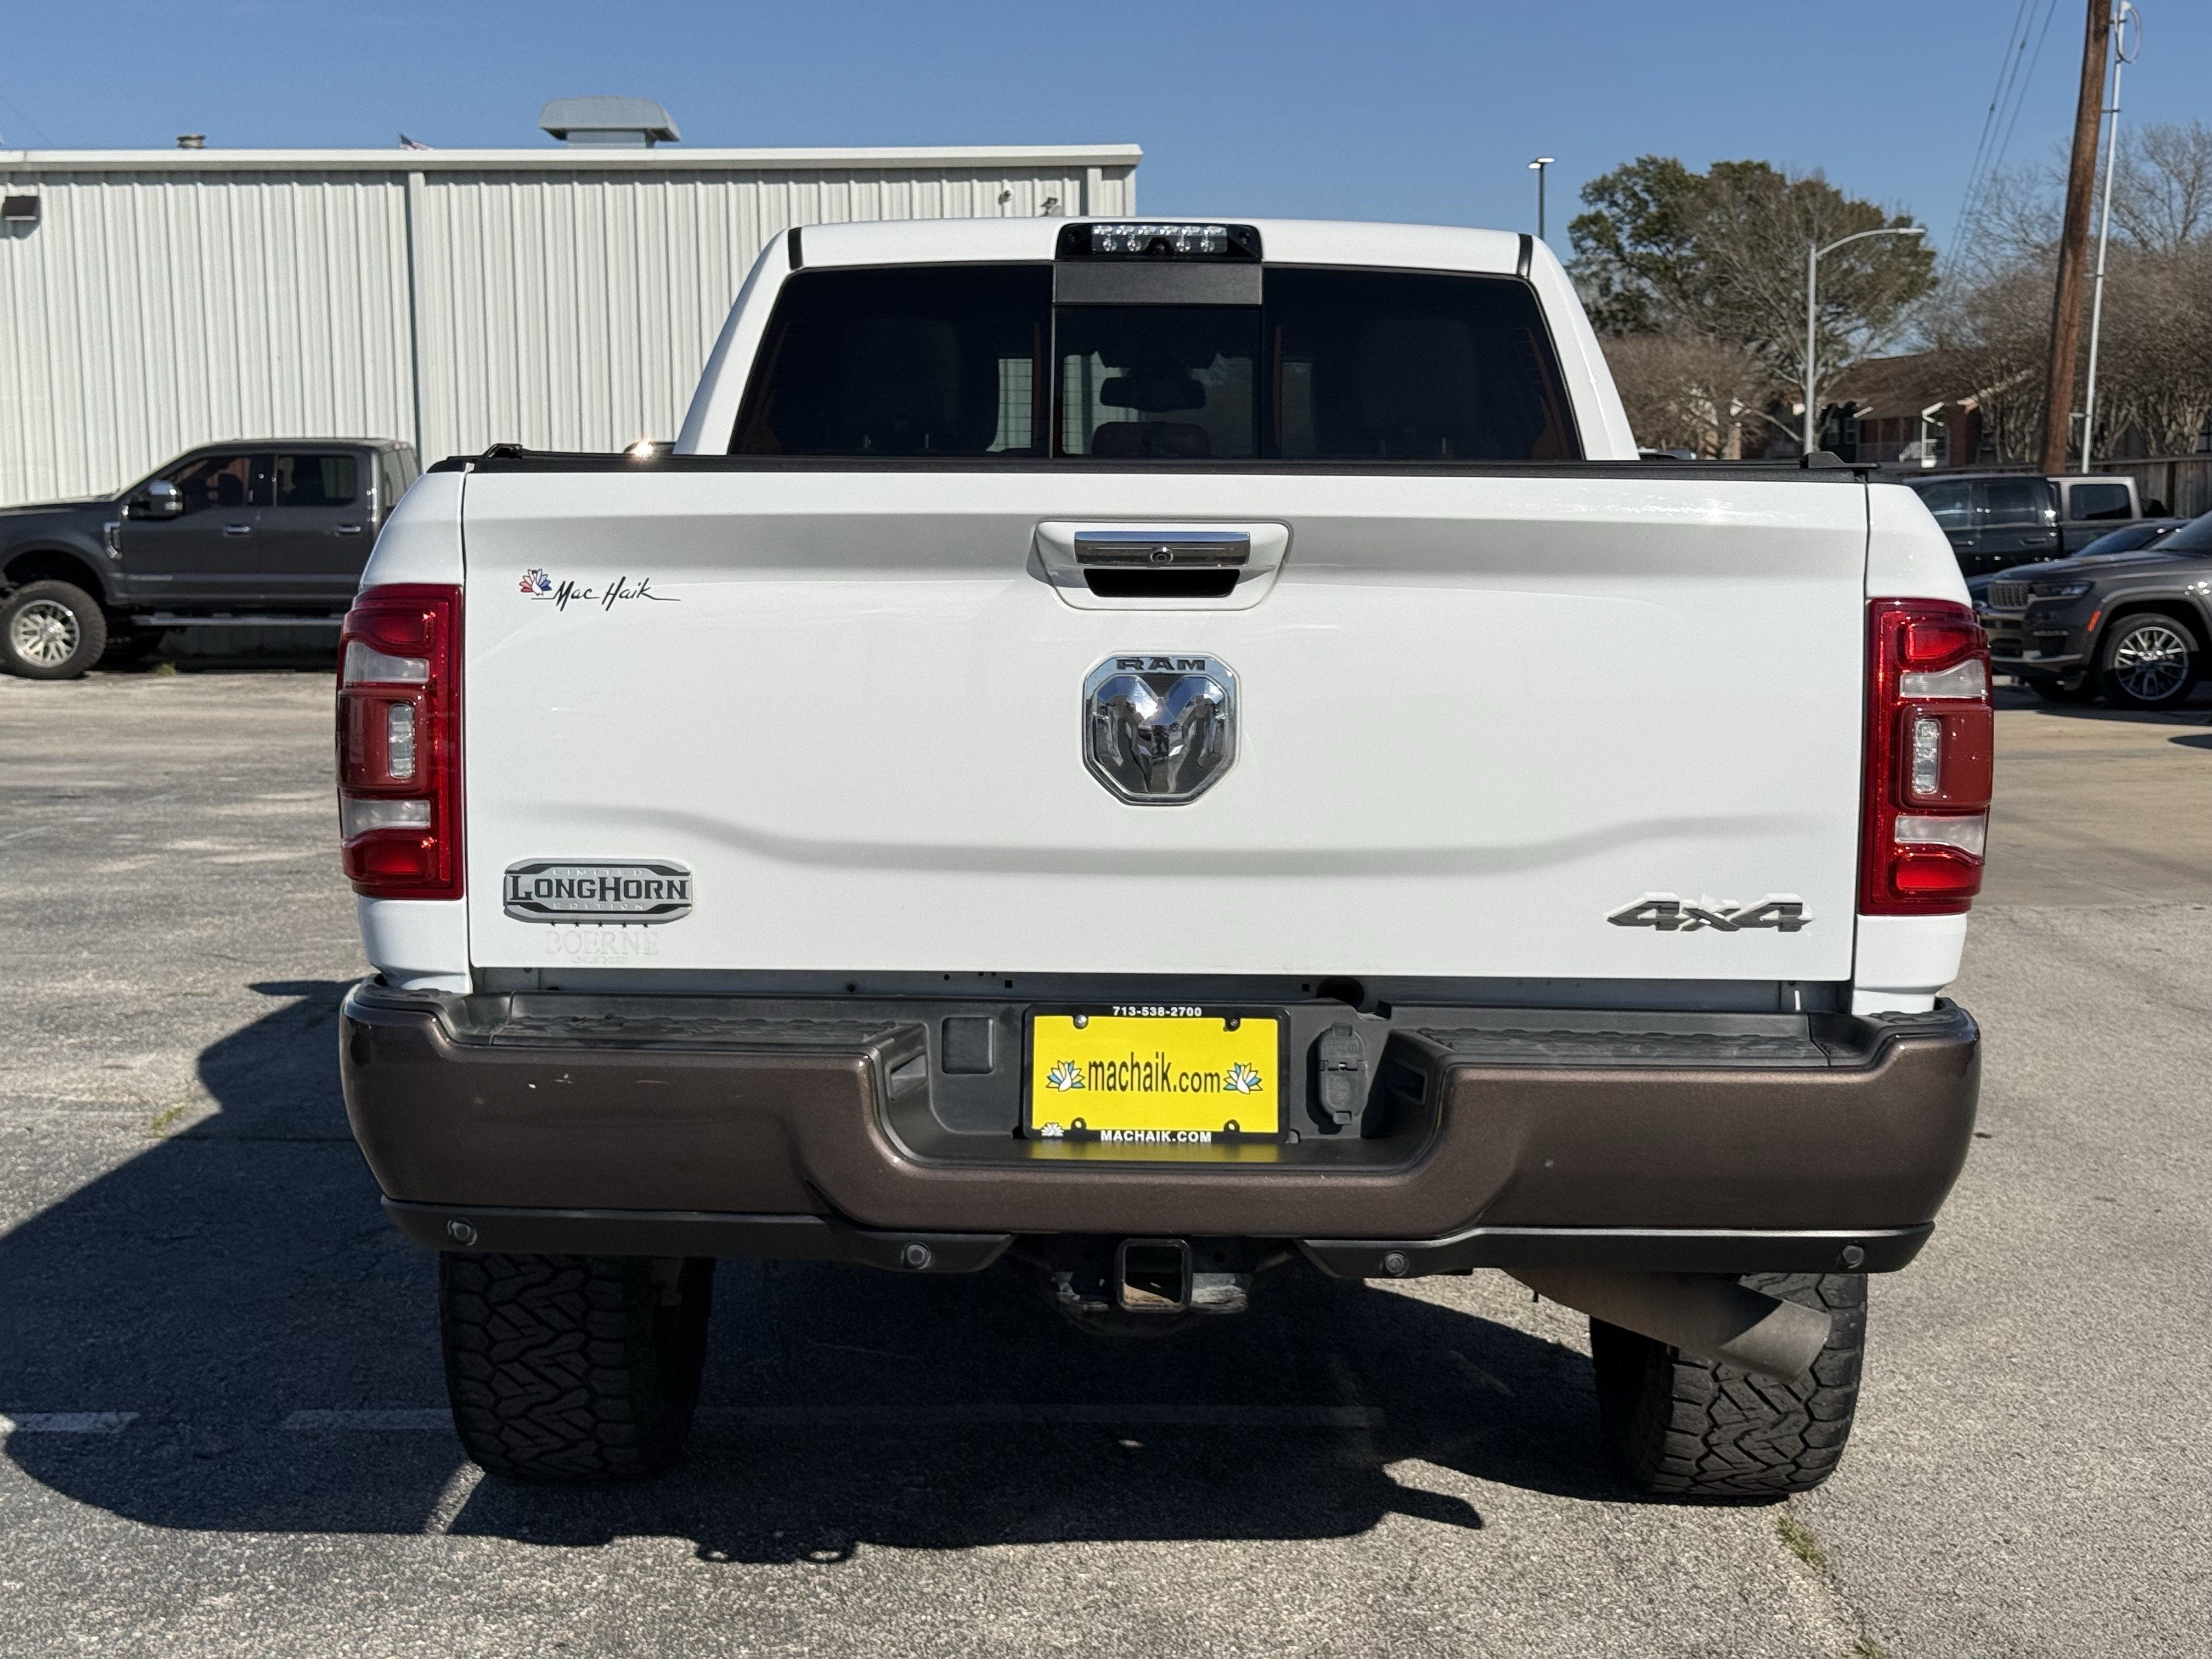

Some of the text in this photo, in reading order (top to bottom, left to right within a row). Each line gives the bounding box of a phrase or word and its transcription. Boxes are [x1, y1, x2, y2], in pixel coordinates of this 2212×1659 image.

[531, 575, 681, 612] Mac Haik
[1117, 658, 1205, 670] RAM
[544, 930, 659, 956] BOERNE
[1112, 1006, 1202, 1017] 713-538-2700
[1088, 1051, 1221, 1093] machaik.com
[1101, 1130, 1212, 1143] MACHAIK.COM
